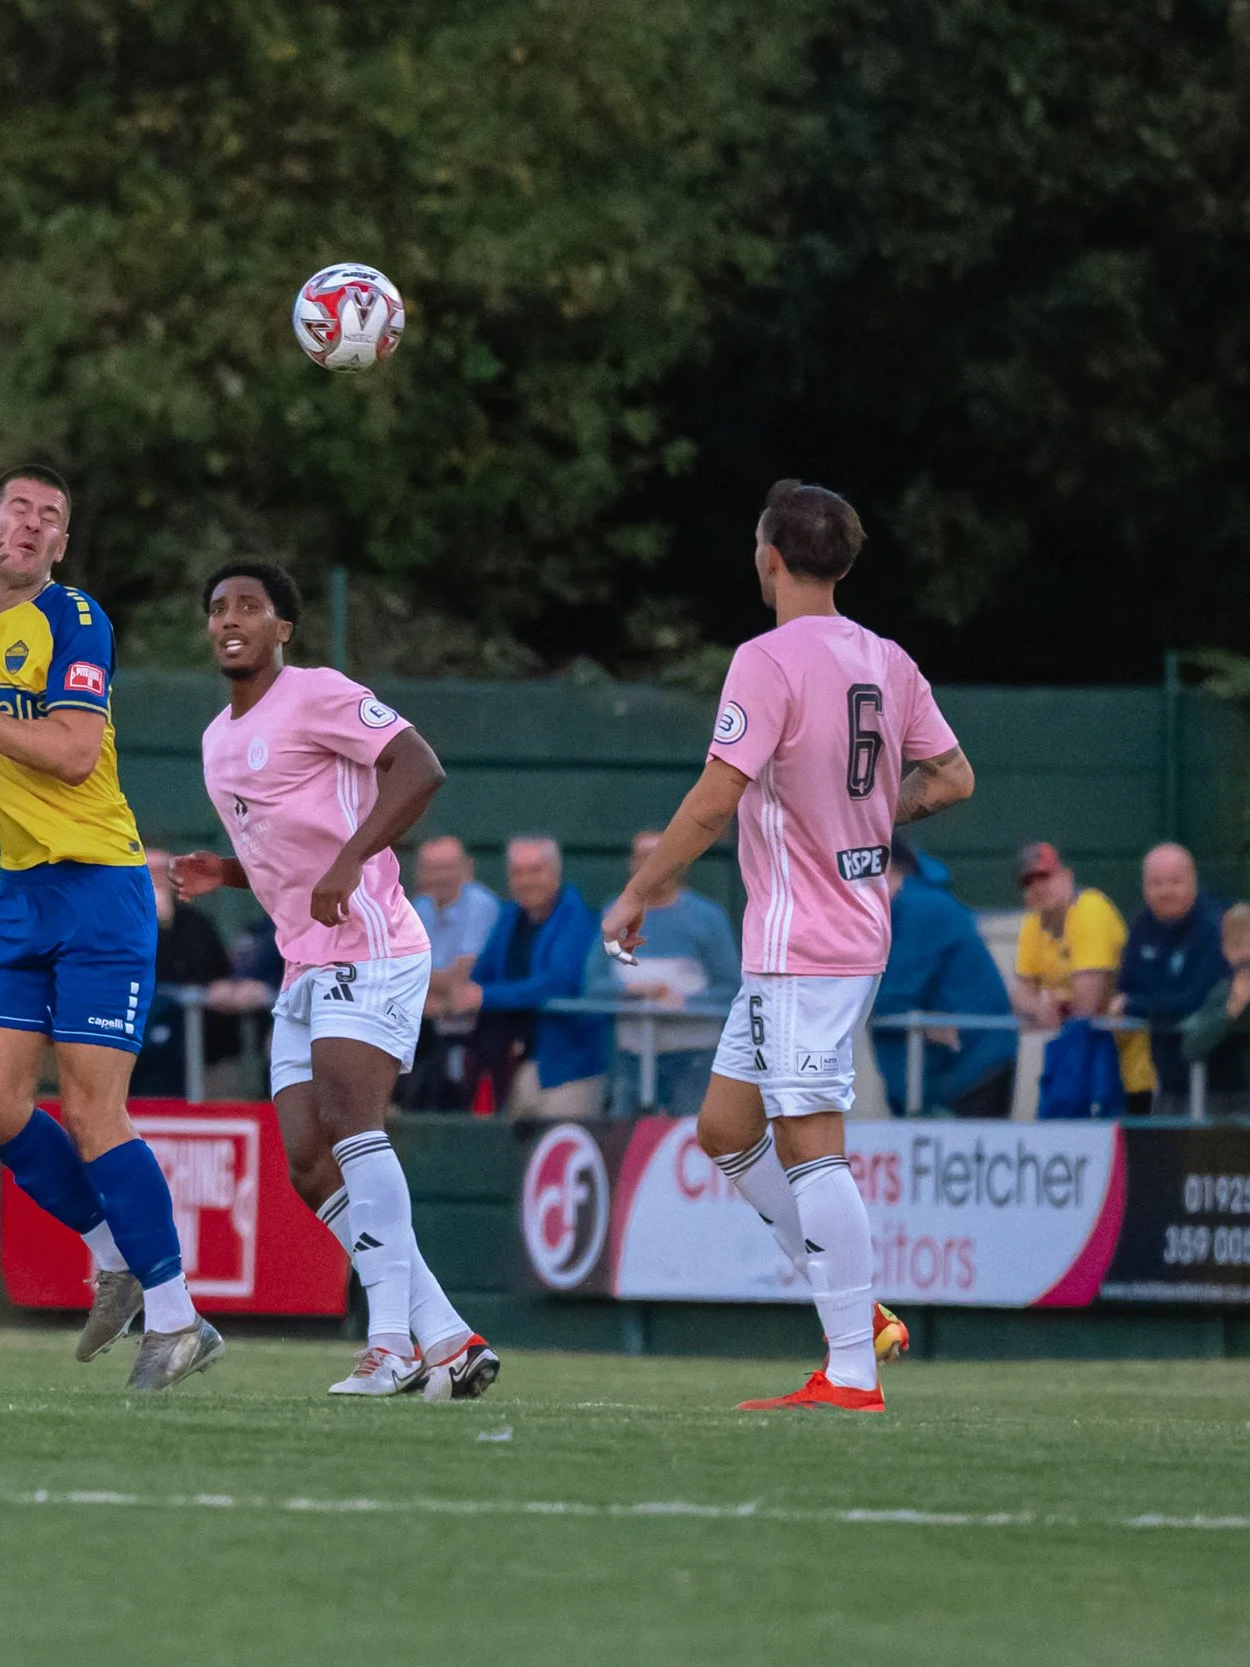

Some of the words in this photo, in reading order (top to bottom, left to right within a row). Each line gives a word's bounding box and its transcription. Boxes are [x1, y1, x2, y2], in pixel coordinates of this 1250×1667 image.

[847, 684, 885, 800] 6
[87, 1016, 124, 1030] capelli
[750, 995, 764, 1046] 6
[909, 1134, 1088, 1208] Fletcher
